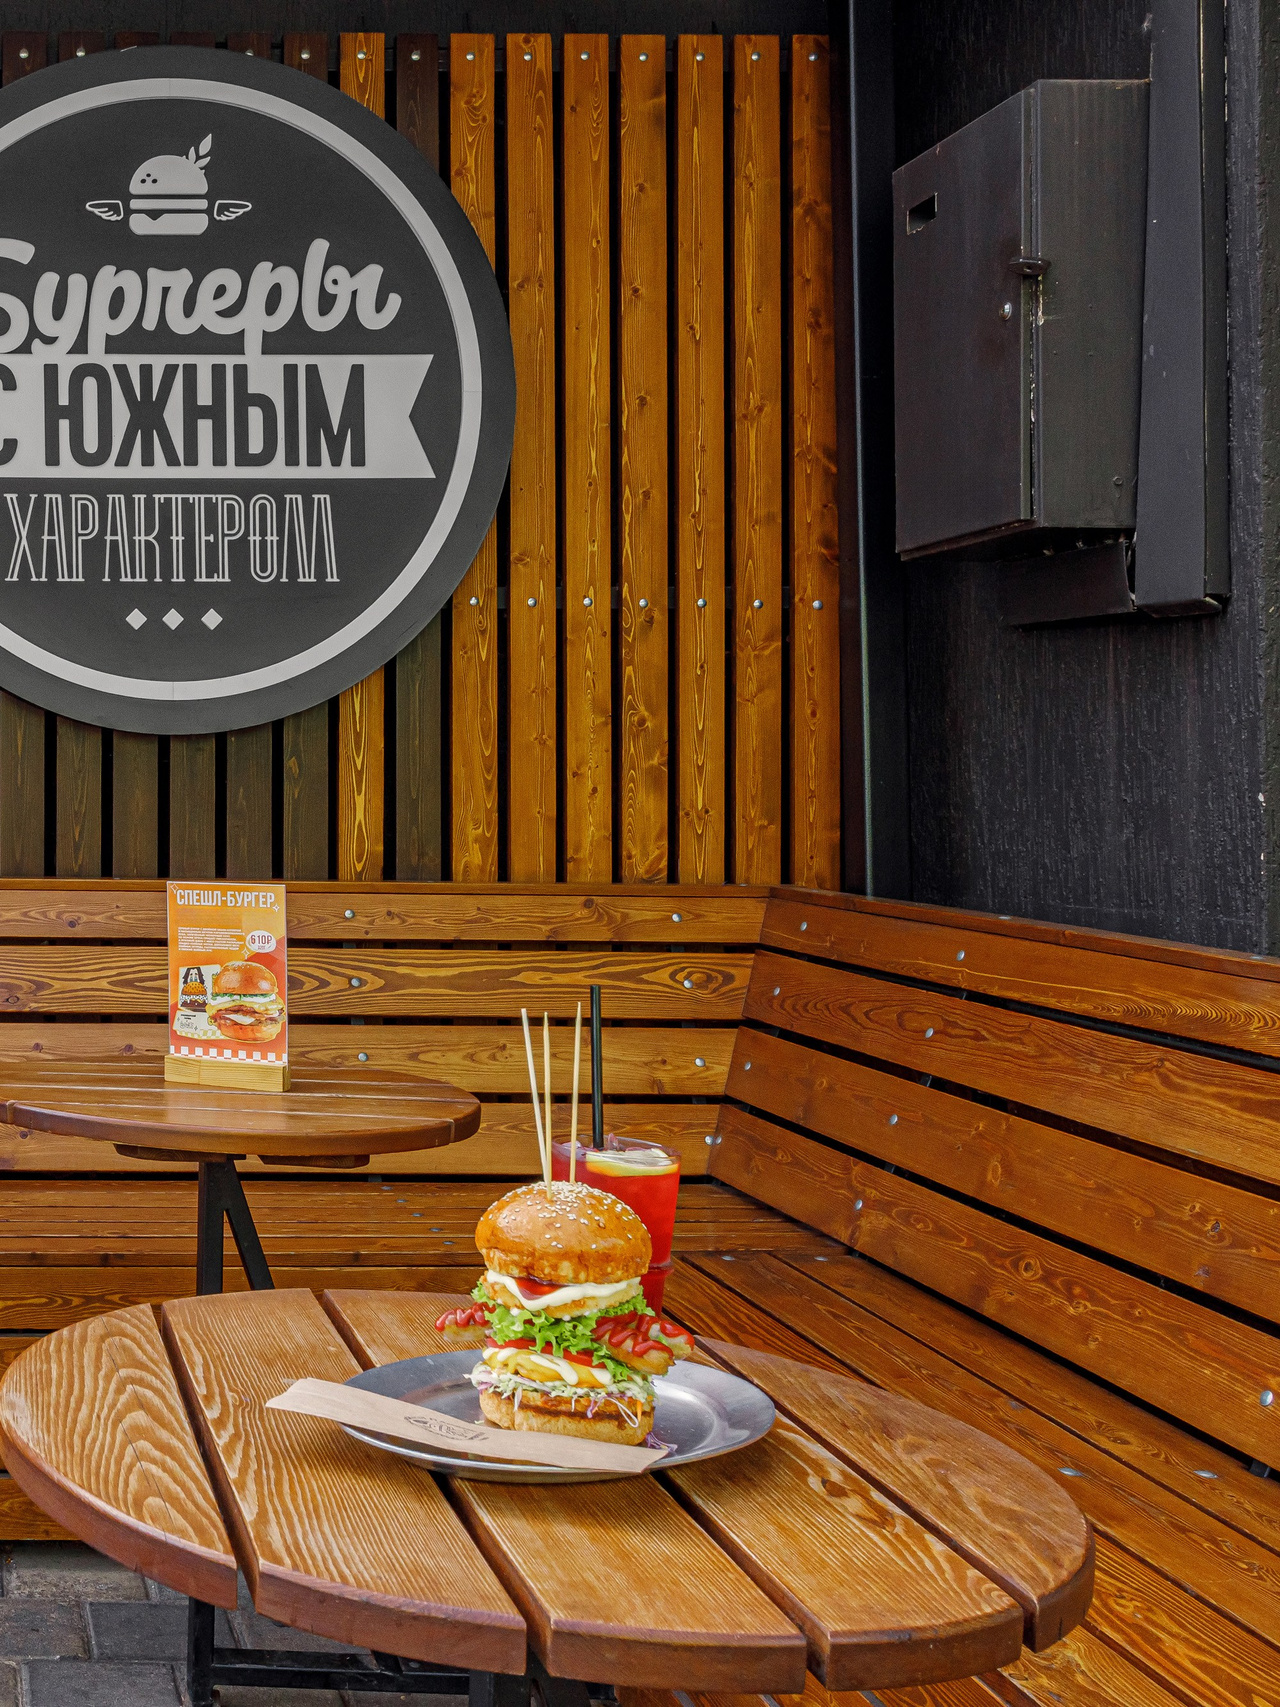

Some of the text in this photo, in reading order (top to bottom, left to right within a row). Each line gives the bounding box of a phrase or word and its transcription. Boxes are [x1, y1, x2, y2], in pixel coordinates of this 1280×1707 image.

[42, 363, 367, 467] ЮЖНЫМ
[3, 493, 341, 583] ХАРАКТЕРОМ
[176, 889, 275, 908] СПЕШЛ-БУРГЕР
